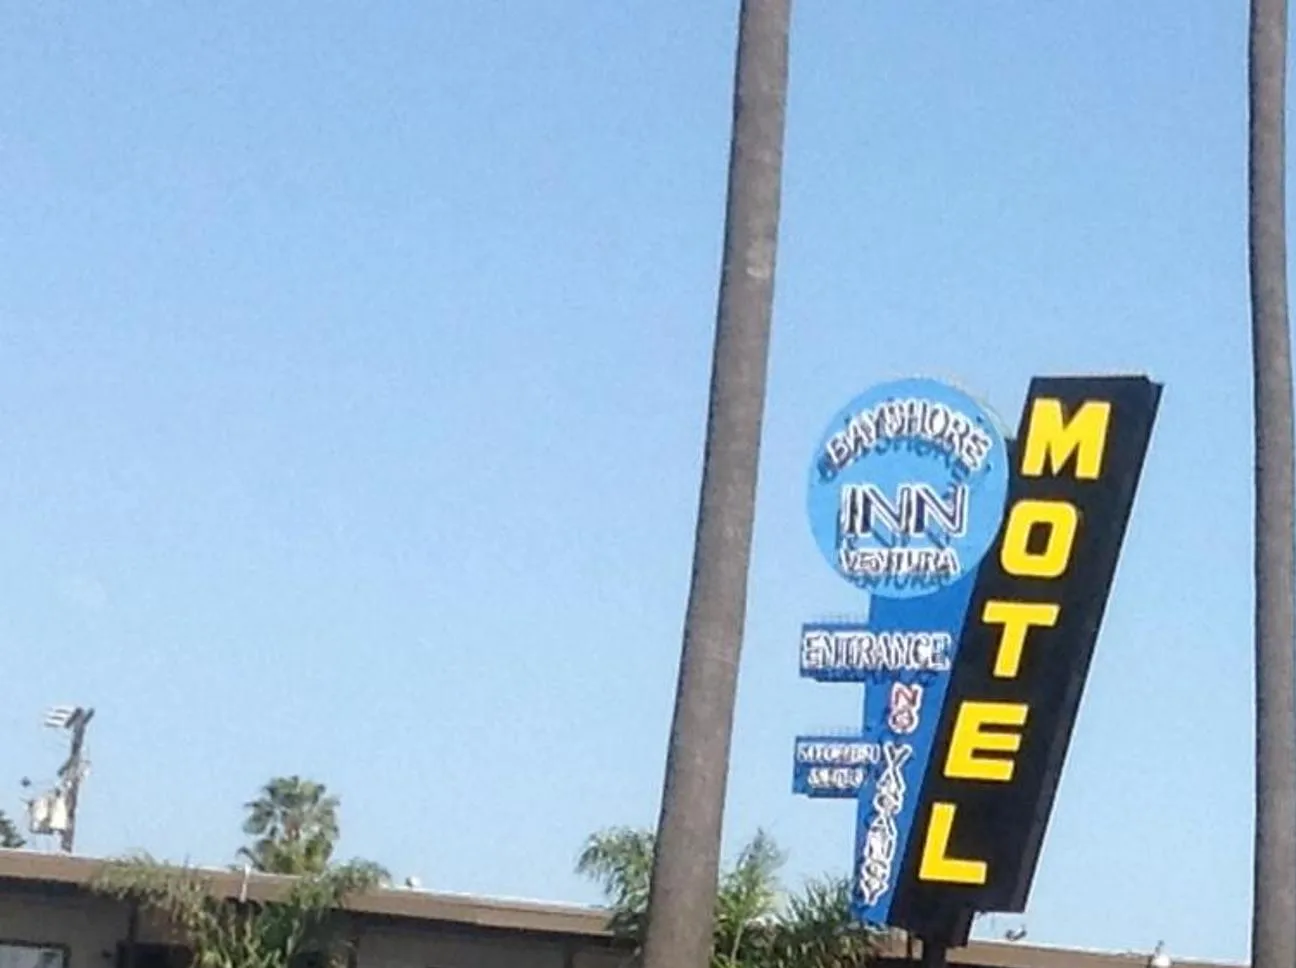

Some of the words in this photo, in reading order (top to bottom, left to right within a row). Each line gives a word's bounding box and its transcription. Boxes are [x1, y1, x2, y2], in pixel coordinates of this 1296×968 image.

[824, 397, 993, 472] BAYSHORE
[840, 482, 969, 539] INN
[838, 547, 962, 576] VENTURA
[803, 629, 952, 670] ENTRANCE
[918, 397, 1112, 885] MOTEL
[888, 682, 923, 734] NO
[860, 741, 913, 906] VACANCY
